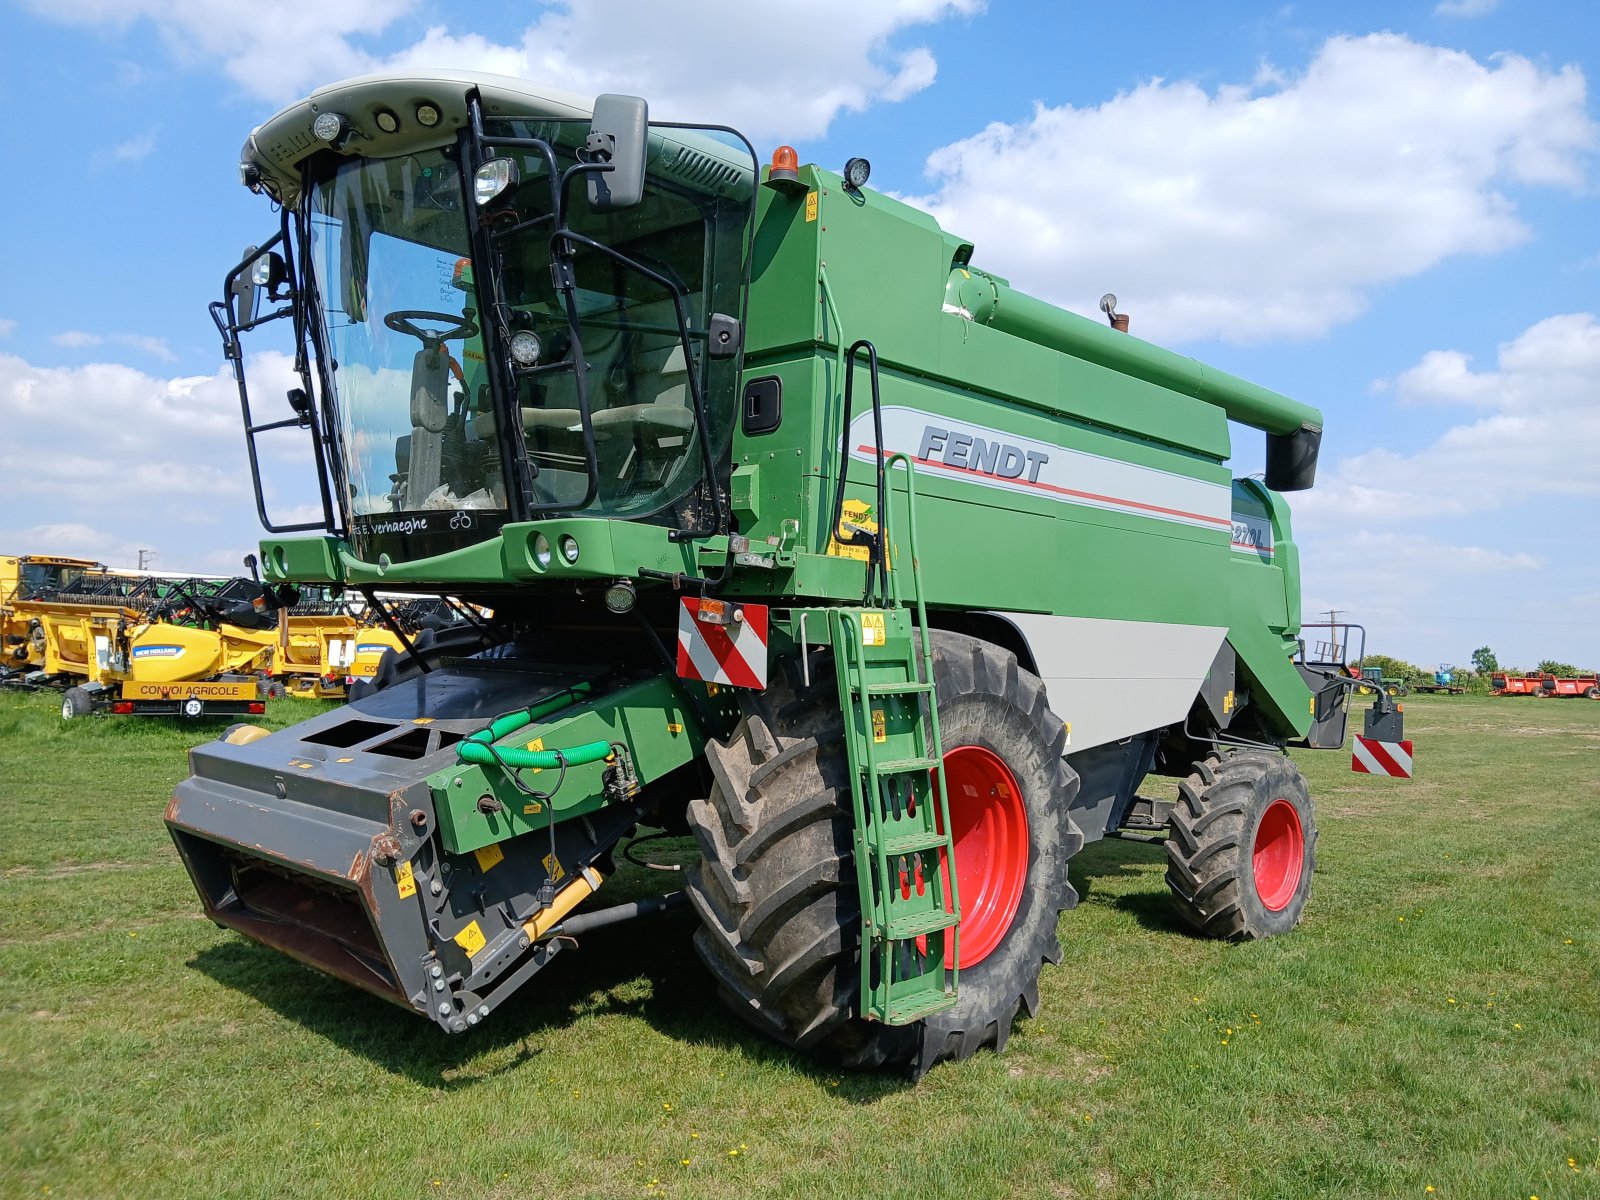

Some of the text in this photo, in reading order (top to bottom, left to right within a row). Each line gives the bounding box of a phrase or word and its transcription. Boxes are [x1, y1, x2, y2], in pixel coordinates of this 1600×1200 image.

[918, 425, 1049, 484] FENDT
[843, 510, 869, 520] FENDT
[140, 685, 239, 696] CONVOI AGRICOLE
[188, 703, 199, 713] 25
